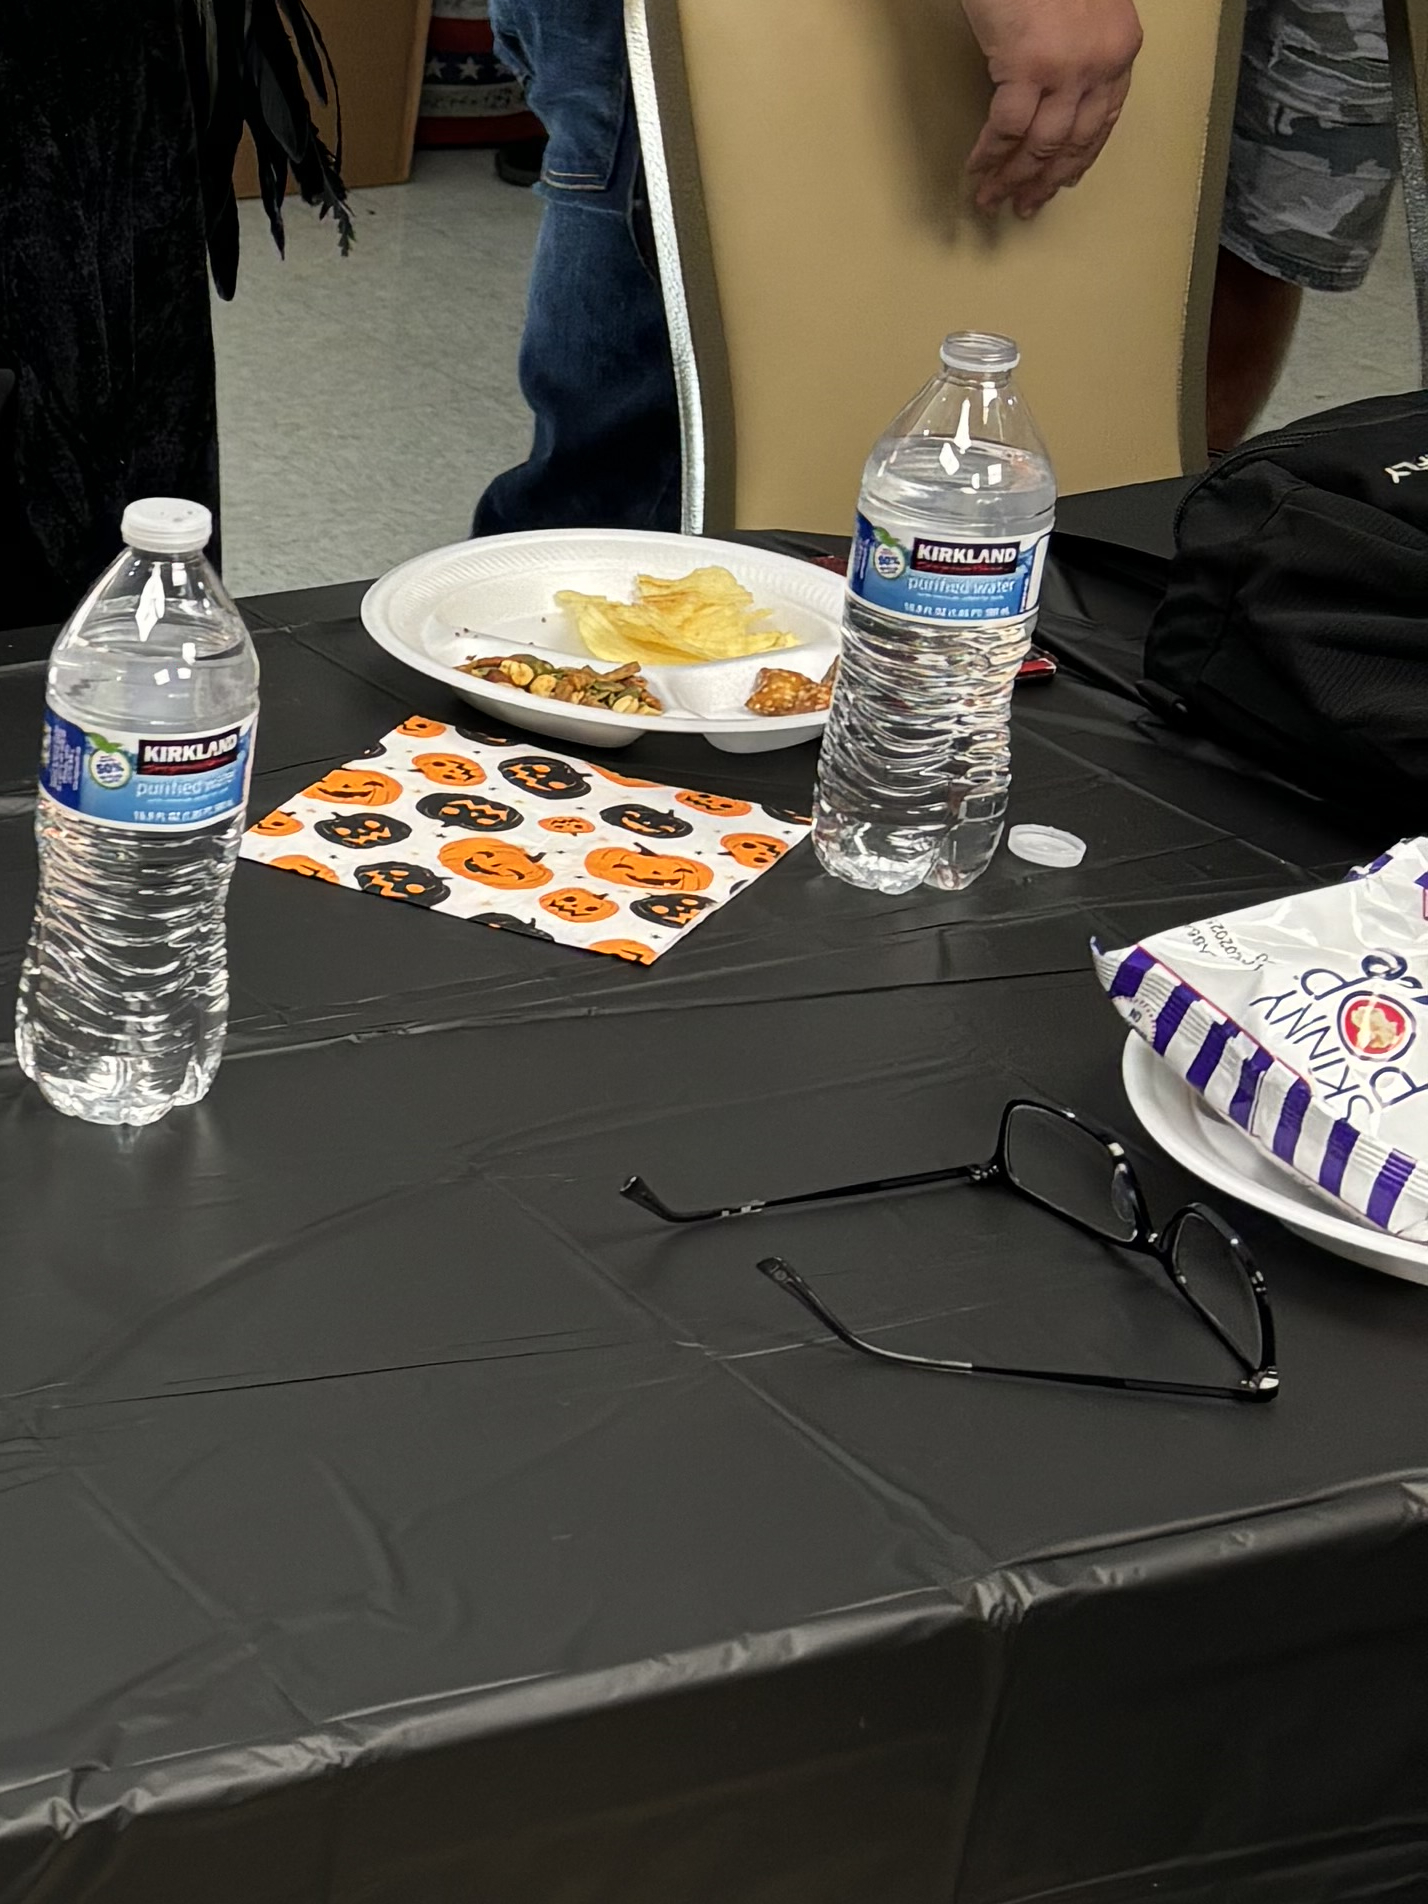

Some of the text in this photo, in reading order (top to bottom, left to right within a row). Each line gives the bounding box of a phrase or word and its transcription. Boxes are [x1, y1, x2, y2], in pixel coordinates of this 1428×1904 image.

[917, 544, 1017, 564] KIRKLAND
[144, 734, 238, 763] KIRKLAND
[1249, 990, 1374, 1124] SKINNY
[1301, 968, 1428, 1108] POP
